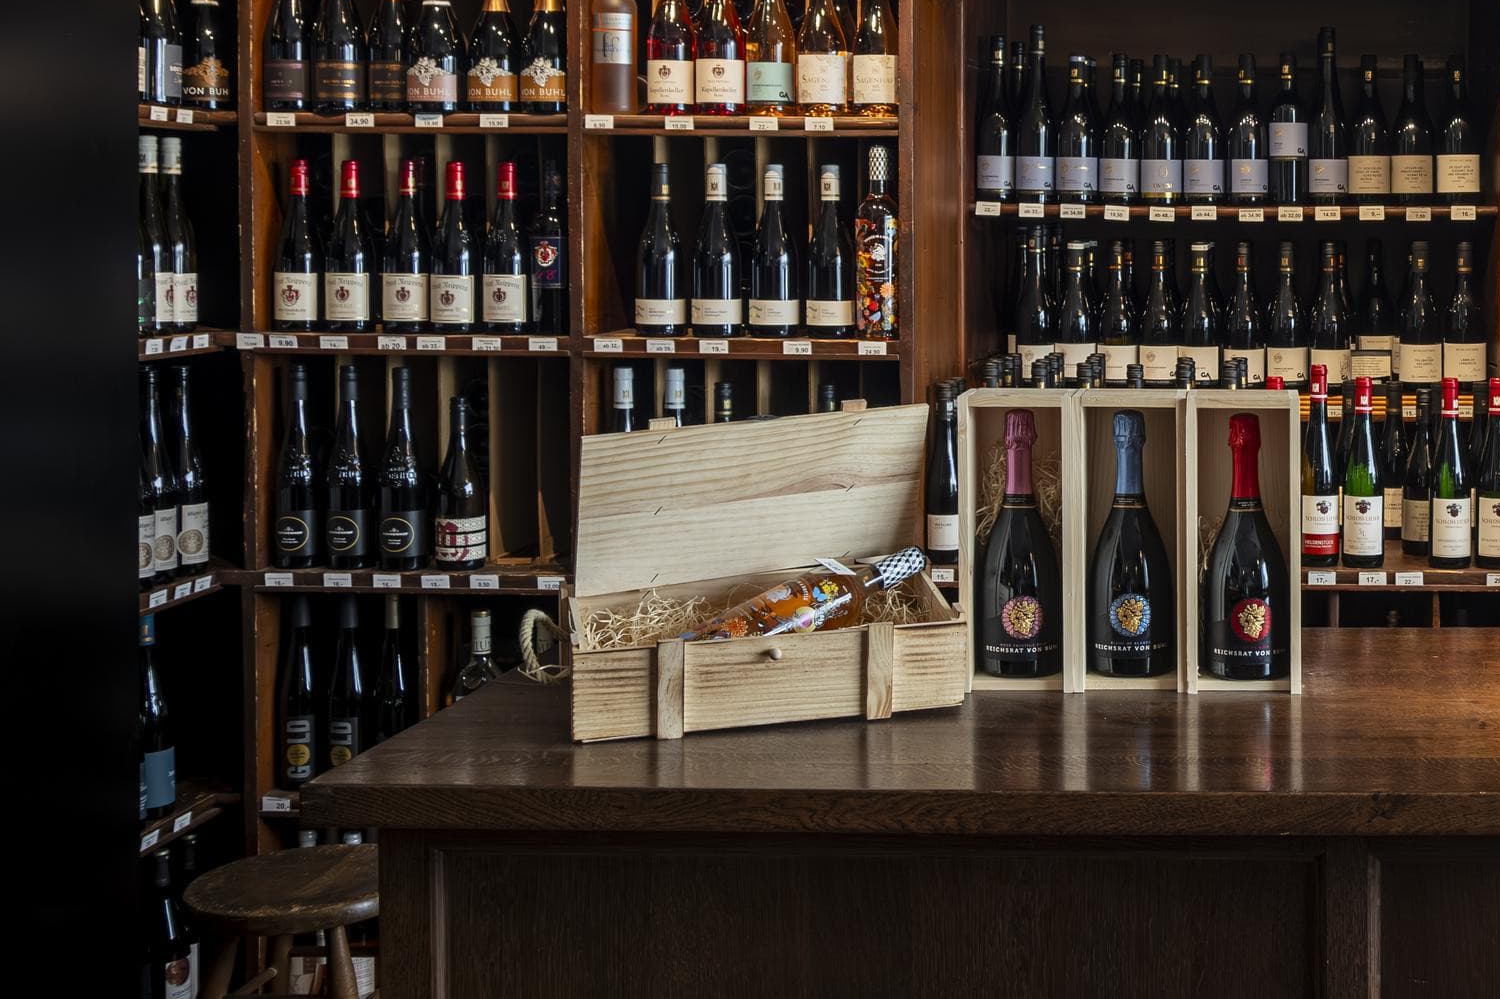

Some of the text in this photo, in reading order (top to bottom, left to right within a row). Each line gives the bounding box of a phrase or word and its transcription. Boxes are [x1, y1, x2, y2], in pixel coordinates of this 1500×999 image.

[183, 87, 229, 96] VON BUH
[423, 87, 451, 96] BUHL
[485, 87, 512, 97] BUHL
[539, 87, 566, 97] BUHL
